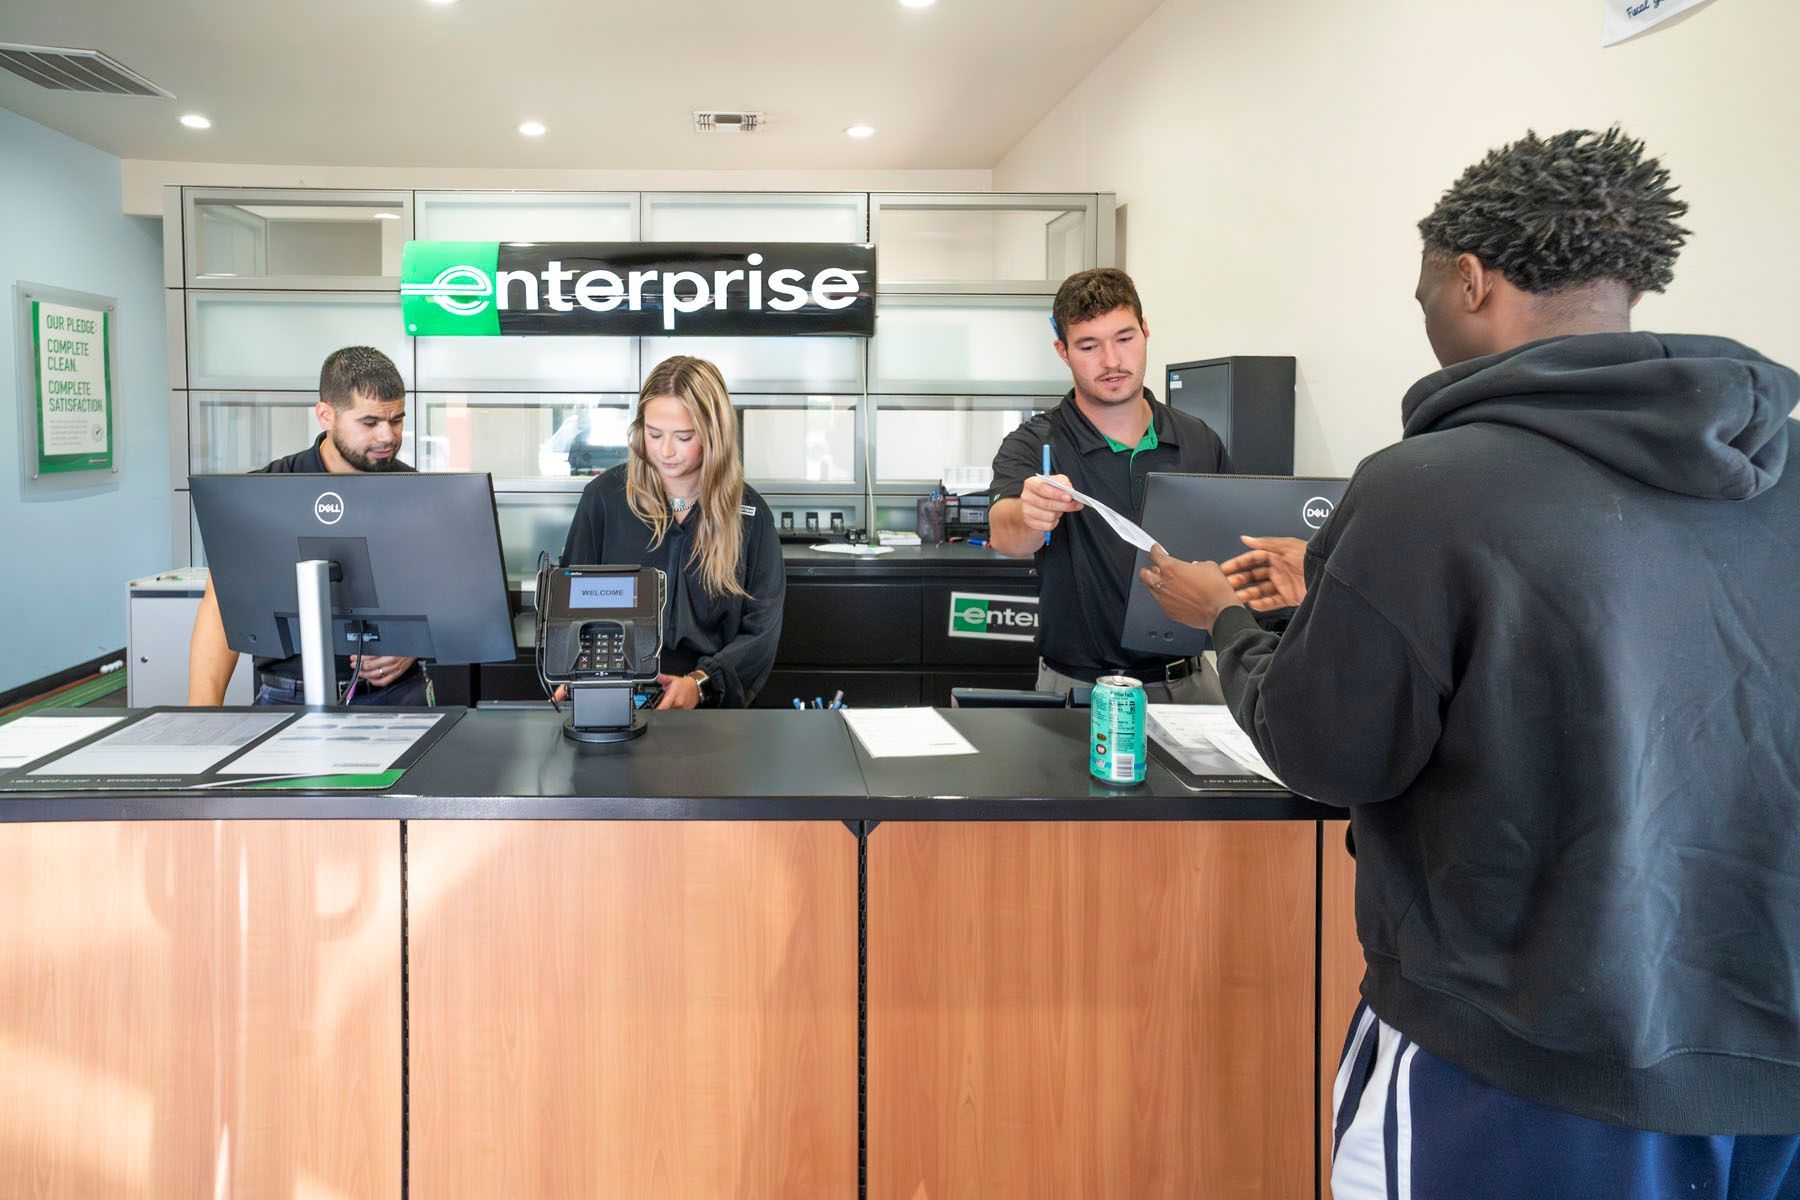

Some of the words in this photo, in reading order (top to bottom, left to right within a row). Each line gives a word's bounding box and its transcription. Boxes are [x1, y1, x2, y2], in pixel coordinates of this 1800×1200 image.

[432, 253, 860, 330] enterprise
[47, 314, 65, 330] OUR
[67, 316, 97, 334] PLEDGE:
[47, 338, 89, 356] COMPLETE
[47, 356, 78, 372] CLEAN.
[48, 379, 91, 396] COMPLETE
[49, 397, 104, 413] SATISFACTION.
[318, 503, 341, 513] DELL
[581, 589, 625, 597] WELCOME
